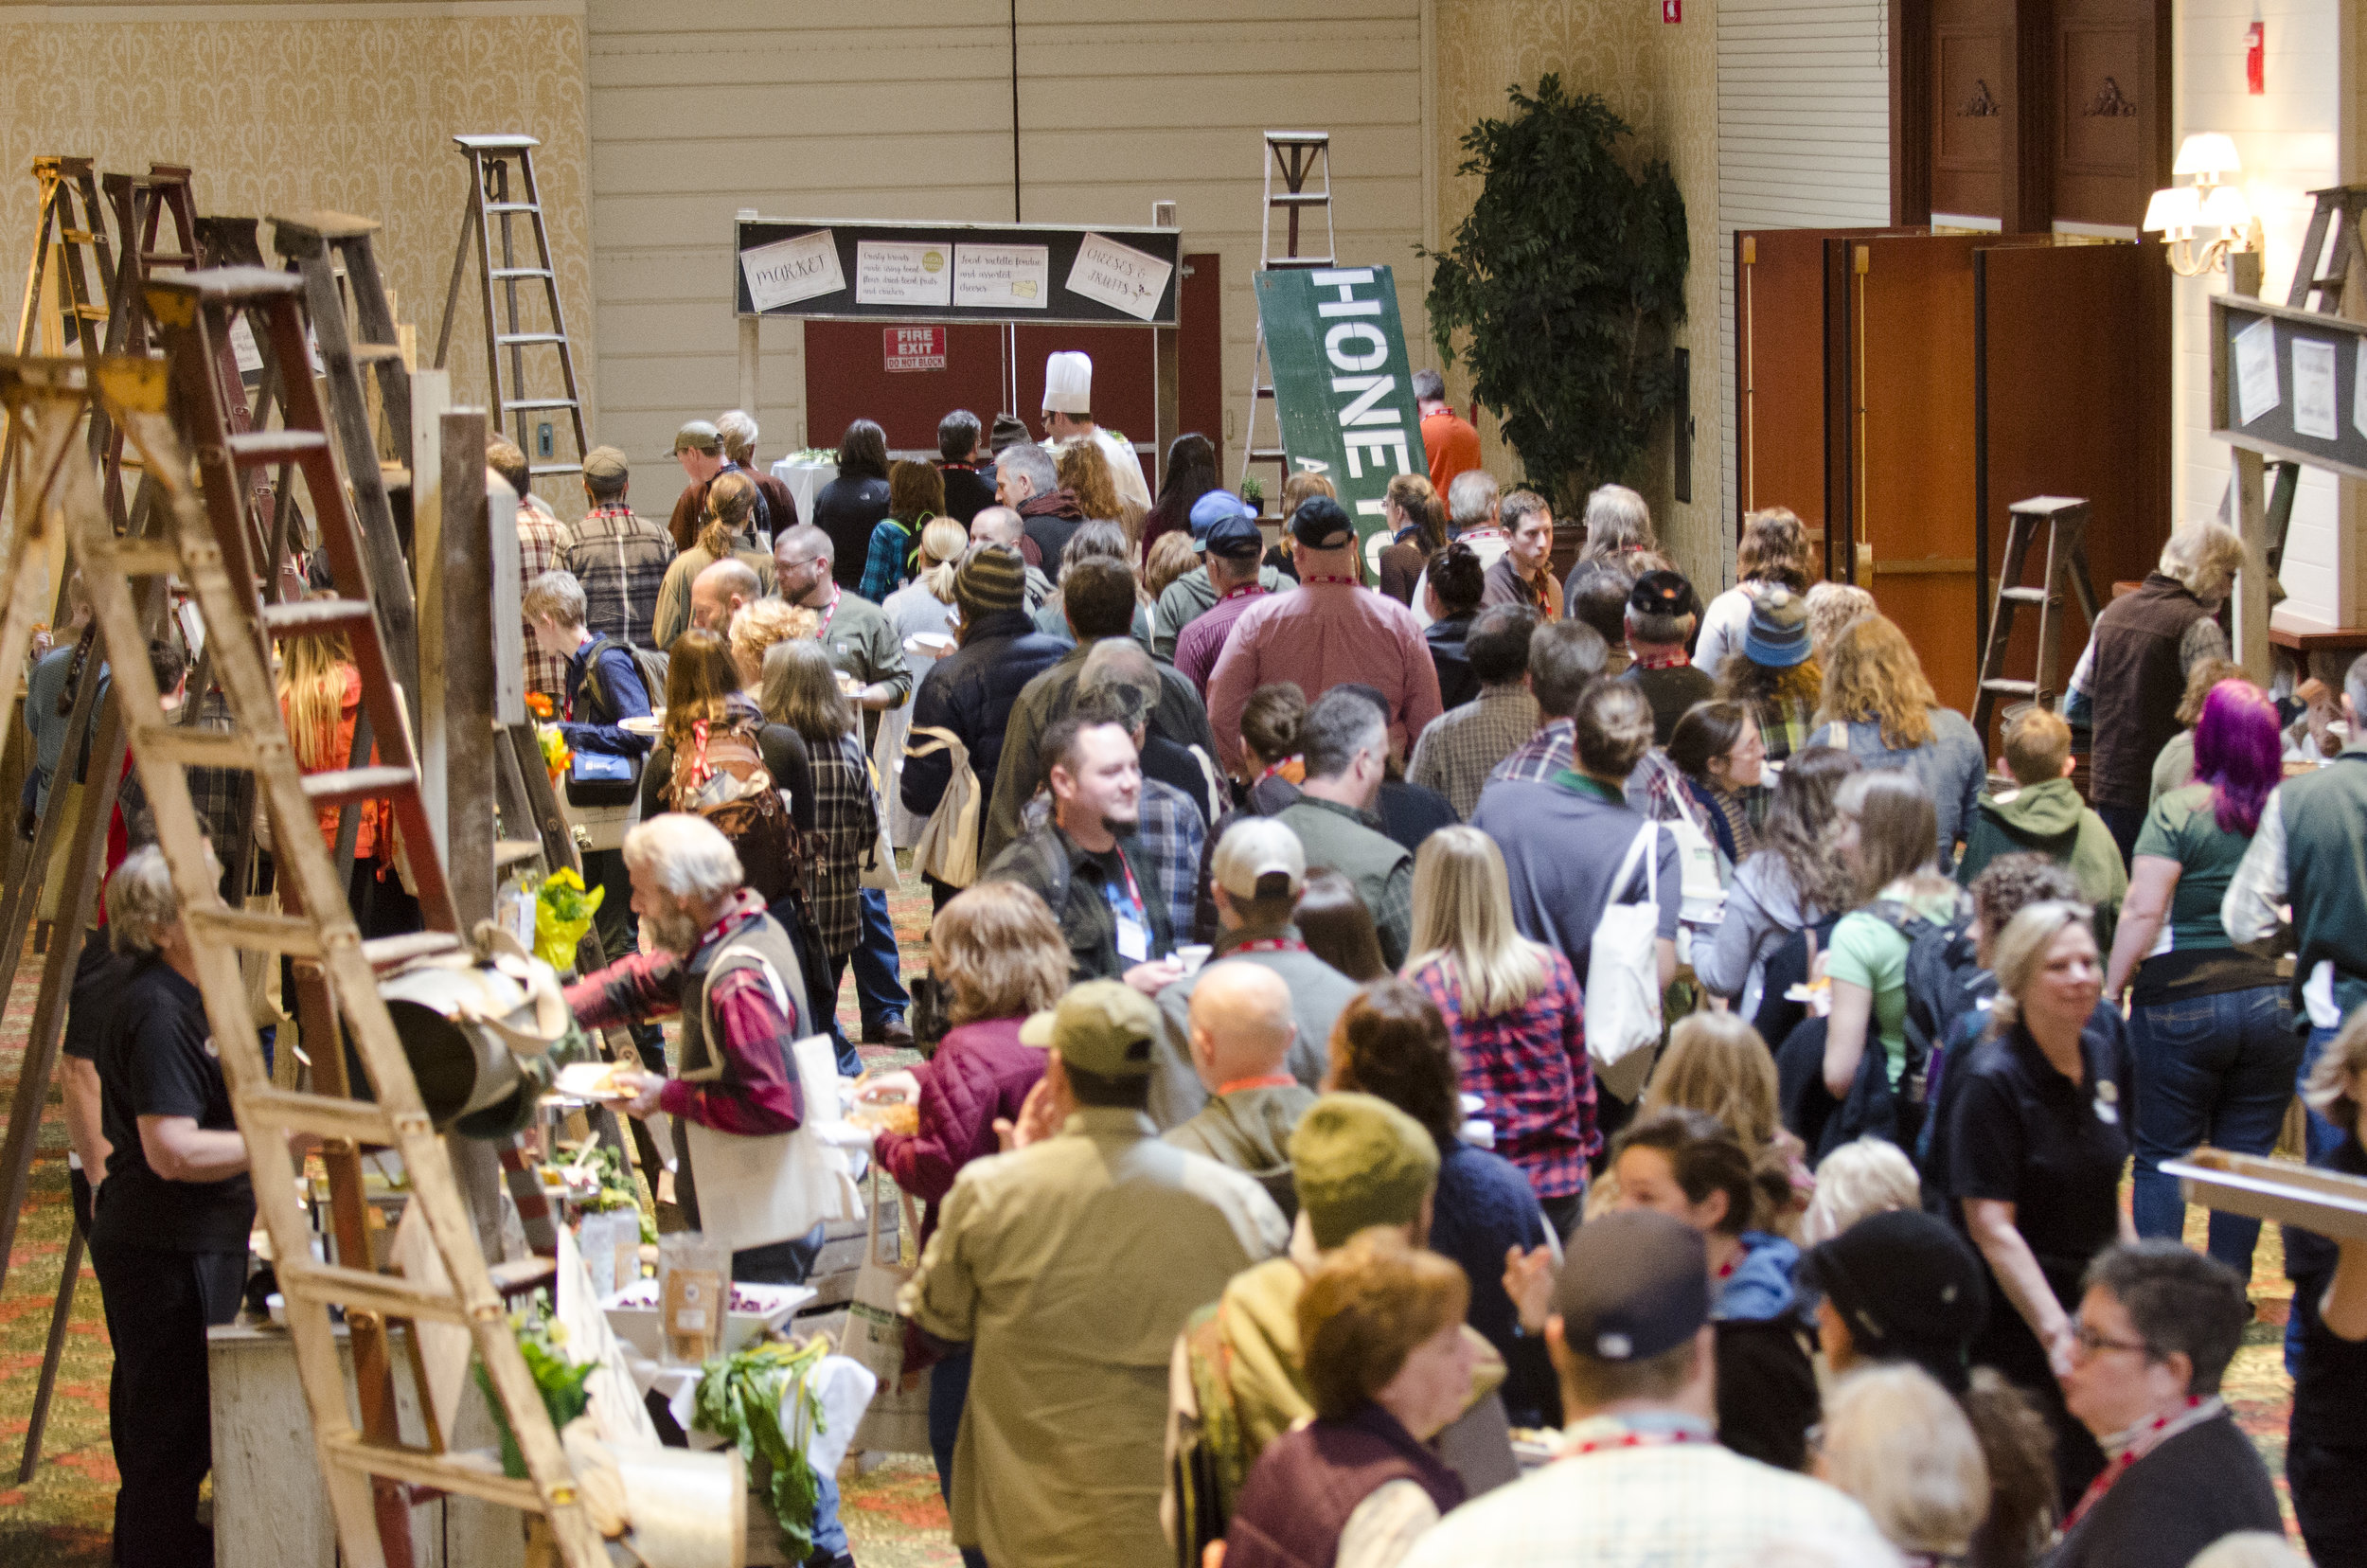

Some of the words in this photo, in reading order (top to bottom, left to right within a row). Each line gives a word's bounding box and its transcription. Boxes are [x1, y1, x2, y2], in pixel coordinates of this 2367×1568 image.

[1087, 248, 1132, 276] CHEESES
[756, 253, 826, 287] MARKET
[959, 269, 975, 279] and
[978, 270, 1012, 279] assorted
[863, 287, 877, 295] and
[959, 282, 988, 293] cheeses
[898, 329, 933, 342] FIRE
[898, 343, 934, 355] EXIT
[888, 359, 899, 368] DO
[901, 359, 917, 368] NOT
[918, 357, 943, 367] BLOCK
